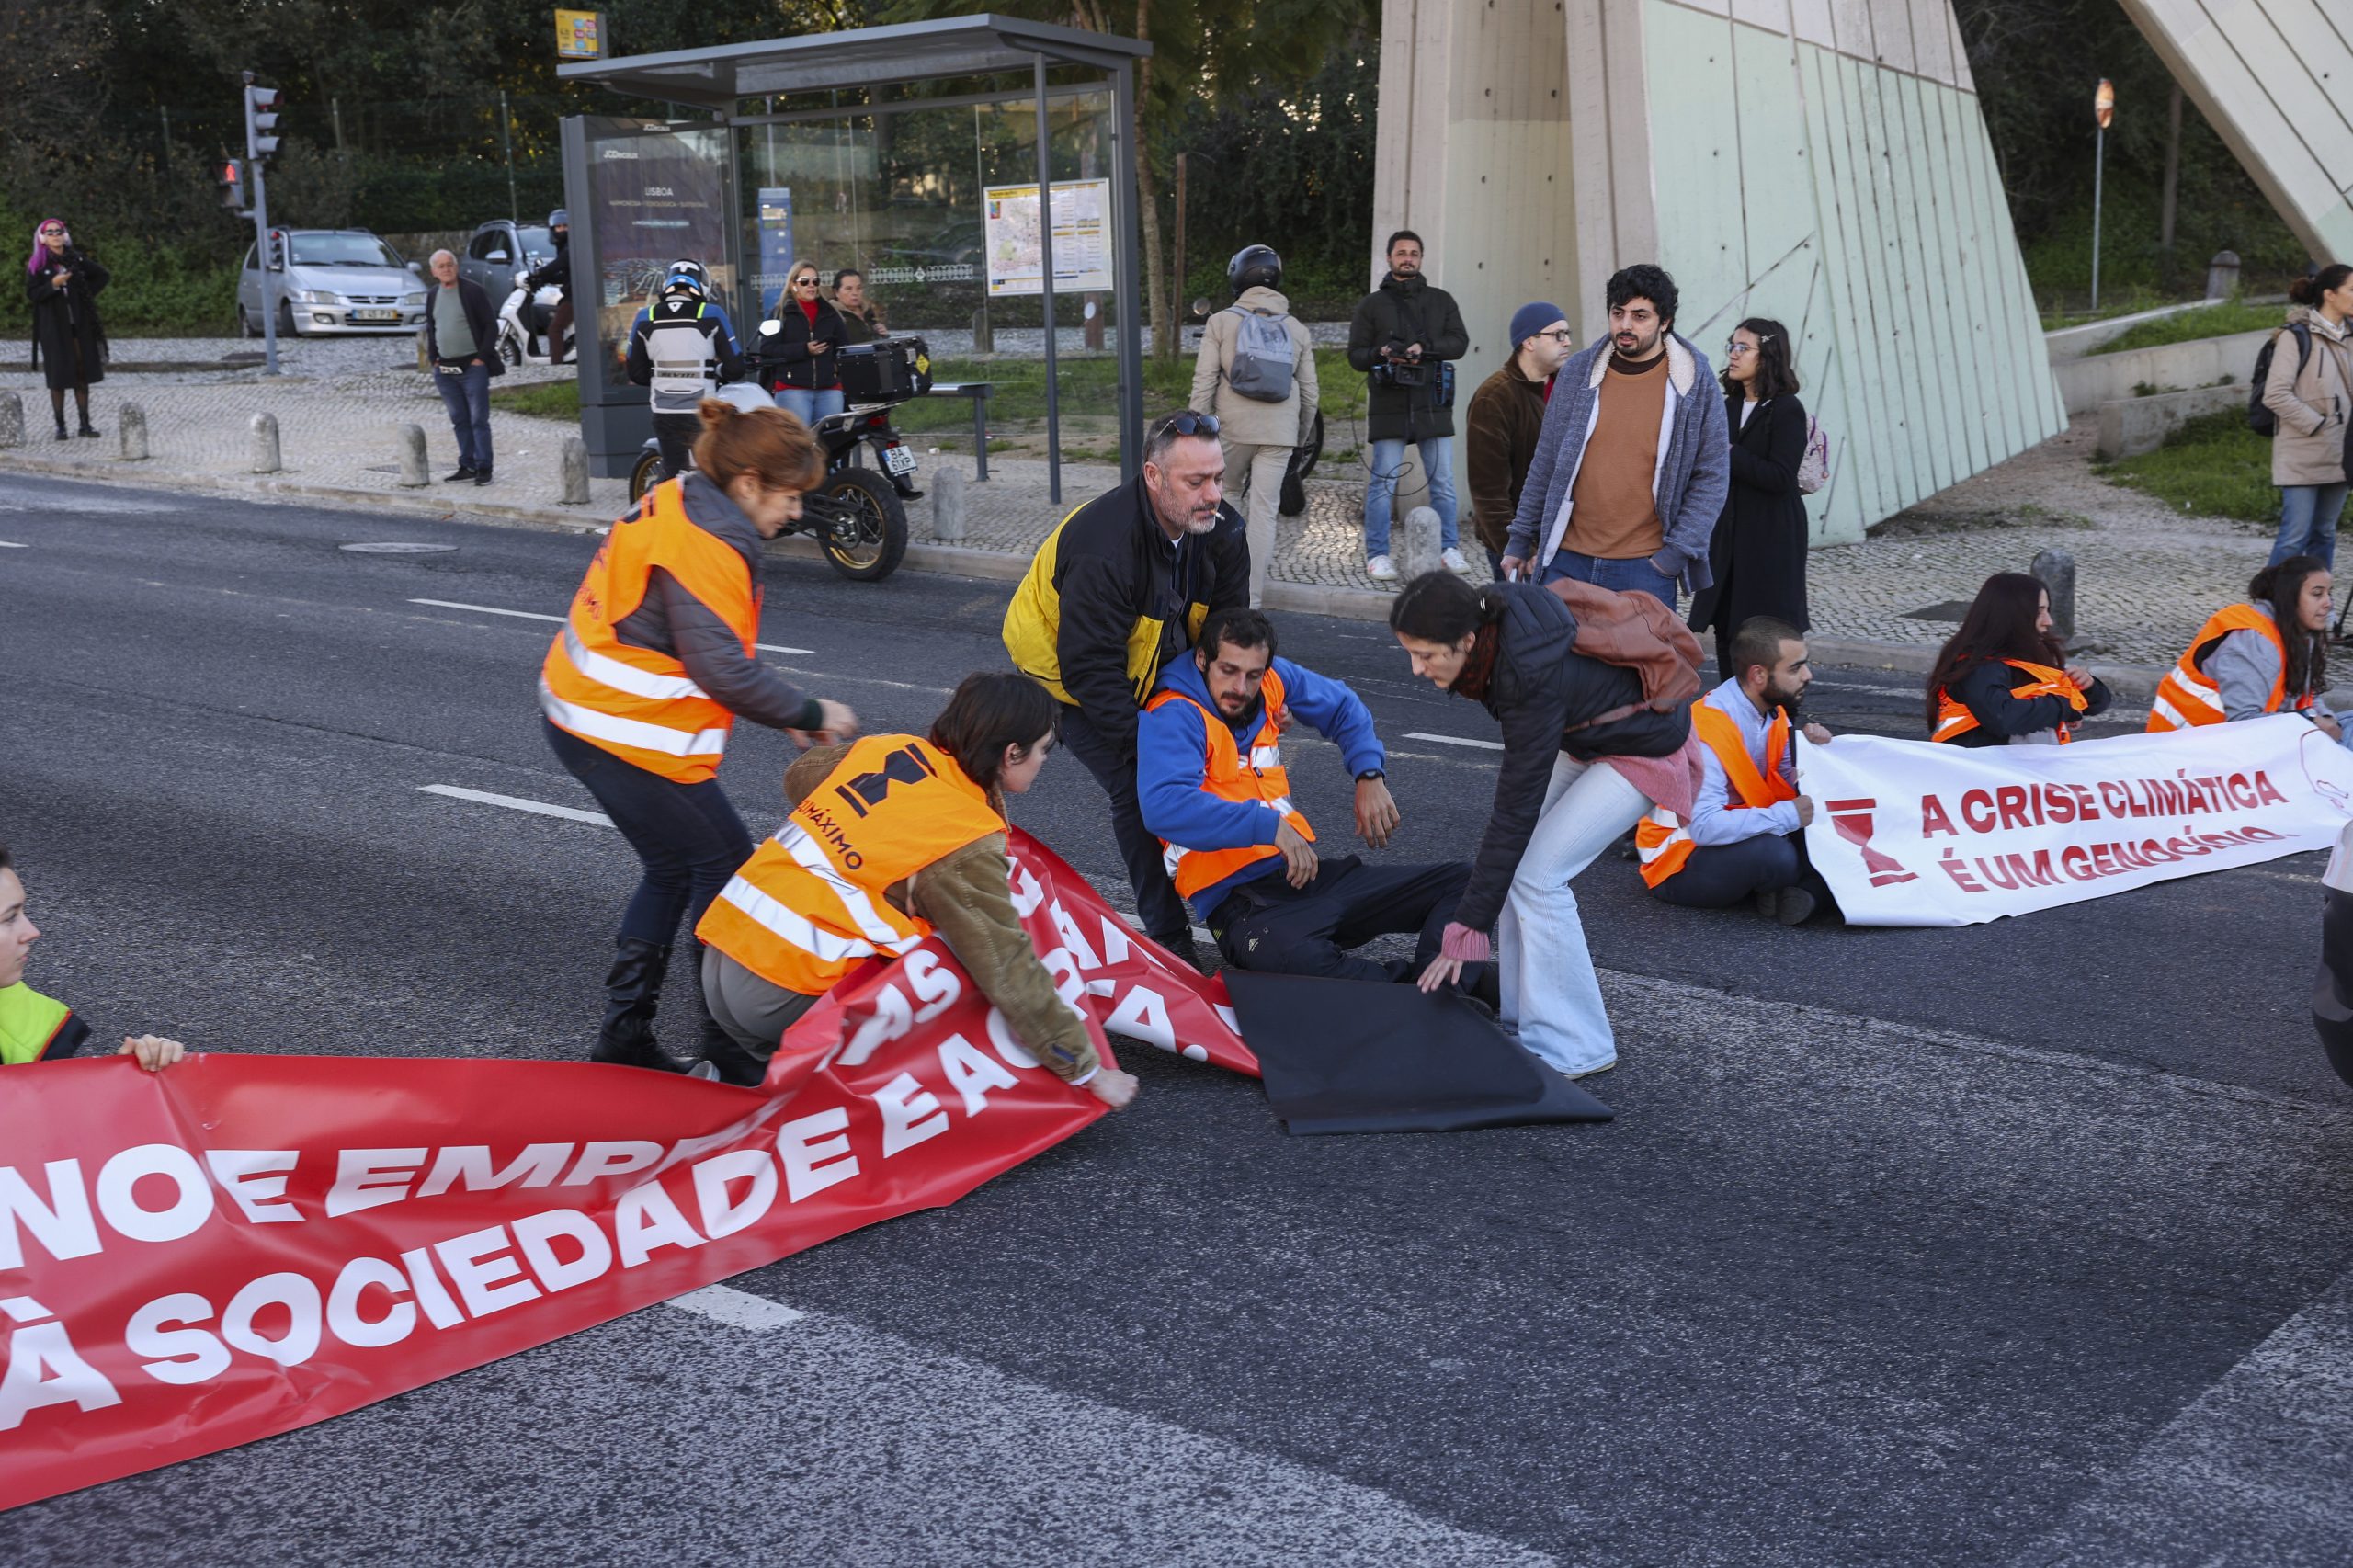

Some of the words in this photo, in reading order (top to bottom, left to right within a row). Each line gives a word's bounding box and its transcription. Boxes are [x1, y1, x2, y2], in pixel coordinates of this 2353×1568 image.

[644, 187, 674, 197] LISBOA
[1922, 793, 1960, 839] A
[1961, 780, 2100, 834] CRISE
[2097, 768, 2290, 820] CLIMÁTICA
[1938, 846, 1989, 893] É
[1973, 848, 2066, 890] UM
[205, 1149, 305, 1224] E
[0, 1295, 123, 1432] À
[124, 1107, 860, 1385] SOCIEDADE
[874, 1072, 950, 1159] E
